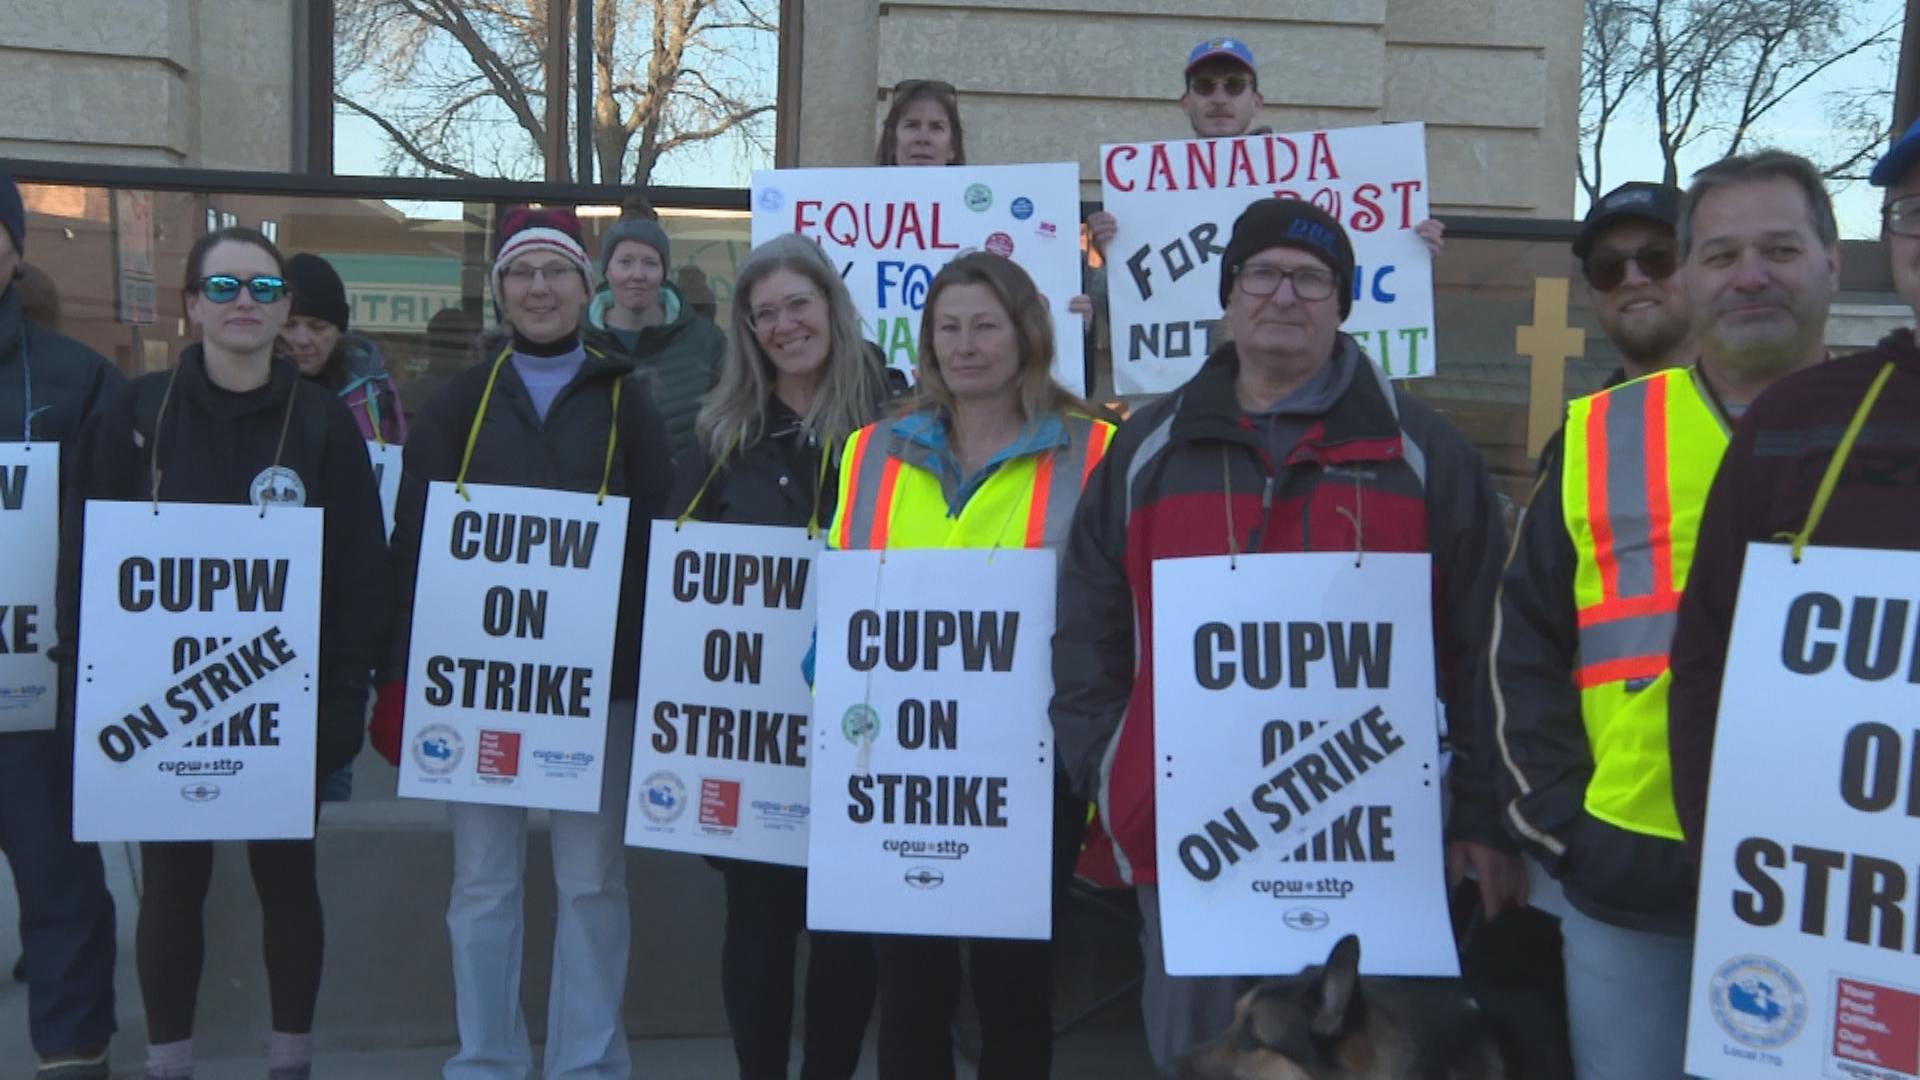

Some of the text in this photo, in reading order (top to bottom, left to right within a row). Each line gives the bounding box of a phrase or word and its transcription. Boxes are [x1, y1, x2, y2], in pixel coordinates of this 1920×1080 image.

[1104, 132, 1340, 192] CANADA
[795, 201, 960, 250] EQUAL
[1273, 180, 1421, 232] OST
[877, 260, 945, 312] FO
[1126, 222, 1225, 302] FOR
[451, 510, 600, 569] CUPW
[118, 556, 290, 613] CUPW
[672, 549, 811, 611] CUPW
[482, 585, 549, 640] ON
[847, 609, 1020, 673] CUPW
[703, 628, 763, 685] ON
[1193, 621, 1393, 691] CUPW
[97, 625, 297, 763] ON STRIKE
[424, 655, 593, 718] STRIKE
[651, 700, 808, 768] STRIKE
[897, 698, 958, 751] ON
[847, 773, 1008, 828] STRIKE
[1178, 704, 1405, 882] ON STRIKE
